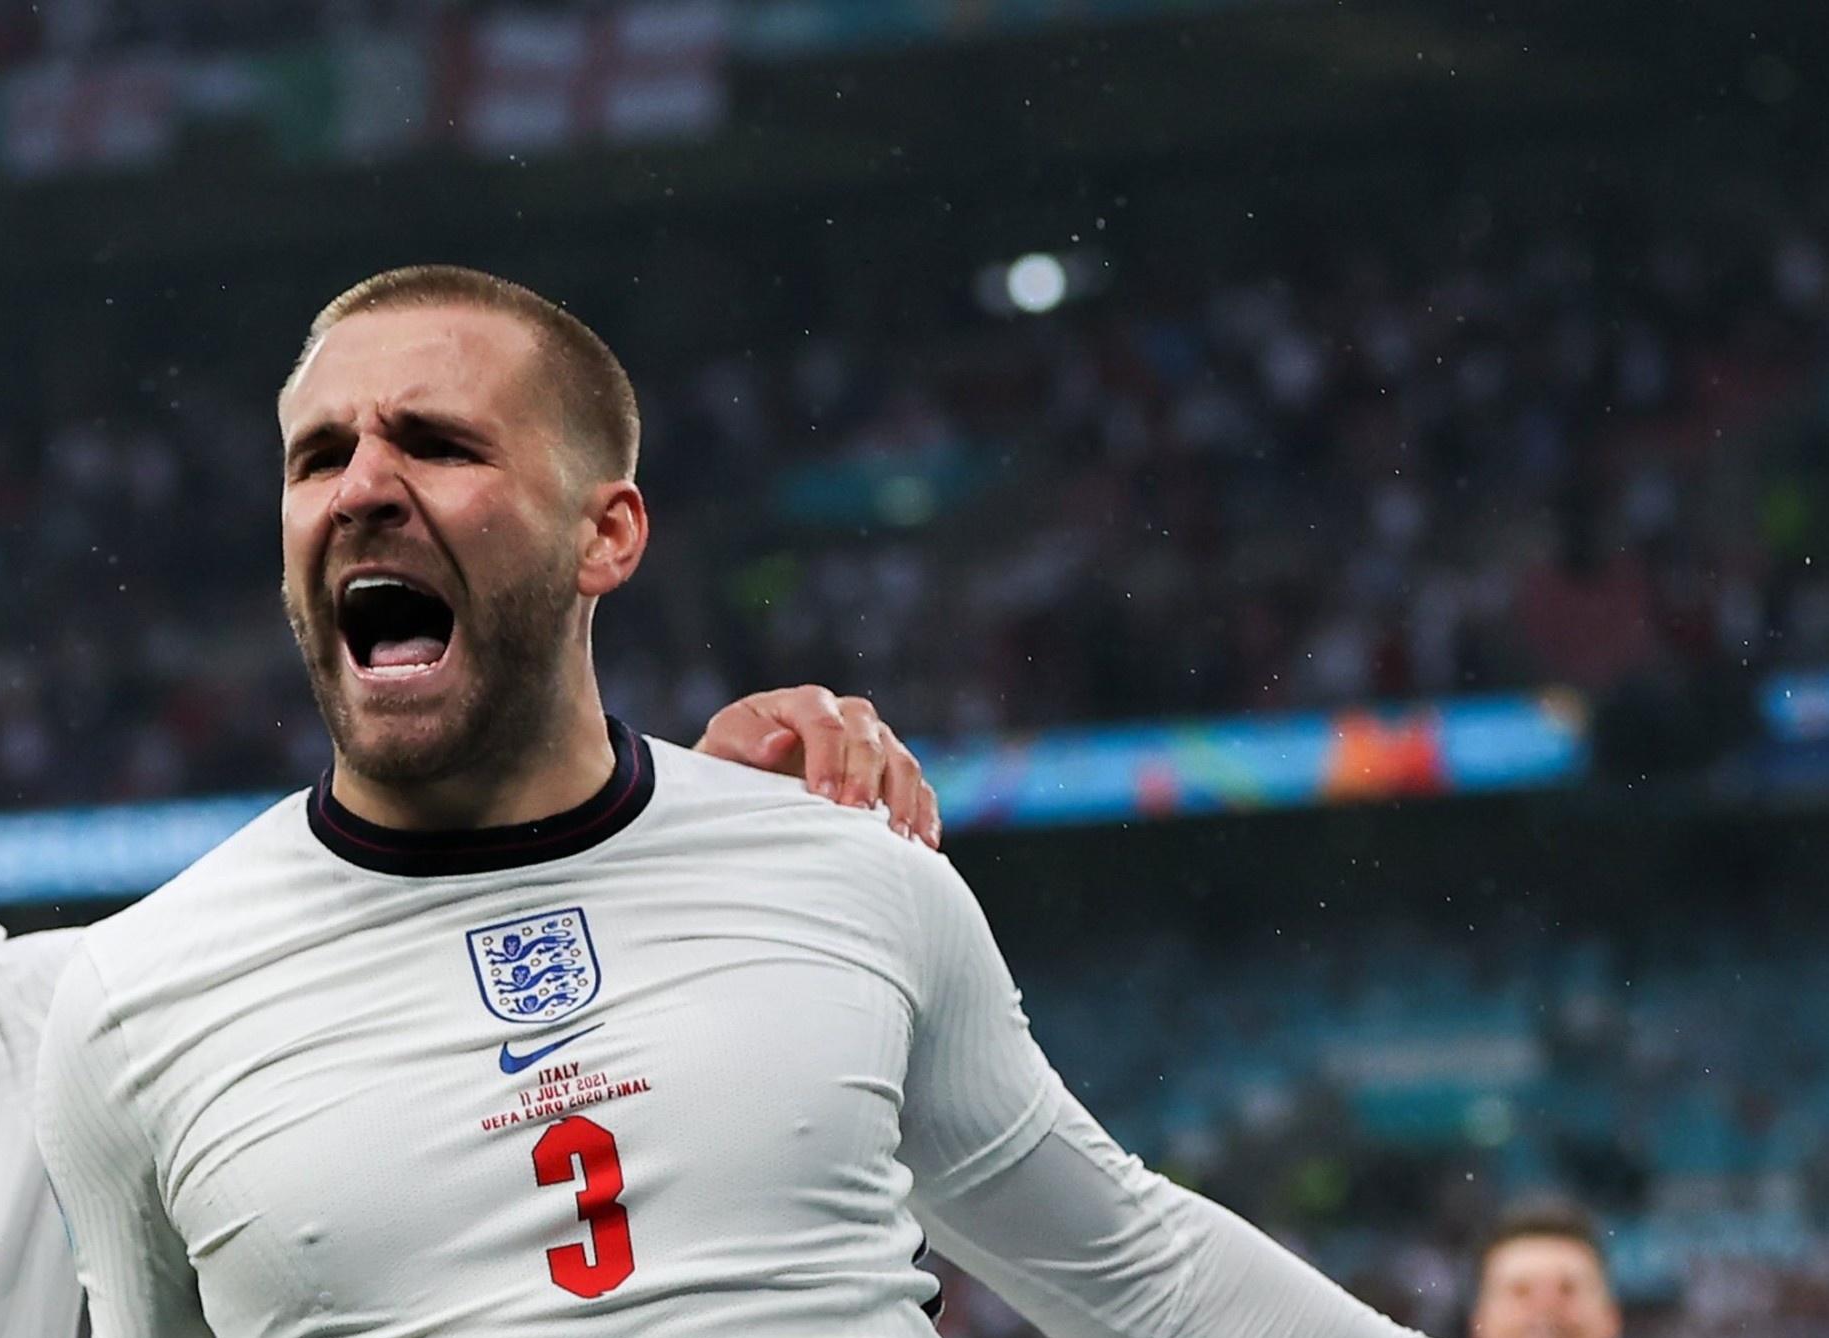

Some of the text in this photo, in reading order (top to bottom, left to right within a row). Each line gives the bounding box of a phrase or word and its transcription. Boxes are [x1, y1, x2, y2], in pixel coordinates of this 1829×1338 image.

[519, 1072, 608, 1106] 11 JULY 2021
[538, 1062, 580, 1085] ITALY
[481, 1078, 652, 1131] UEFA EURO 2020 FINAL
[531, 1115, 635, 1299] 3
